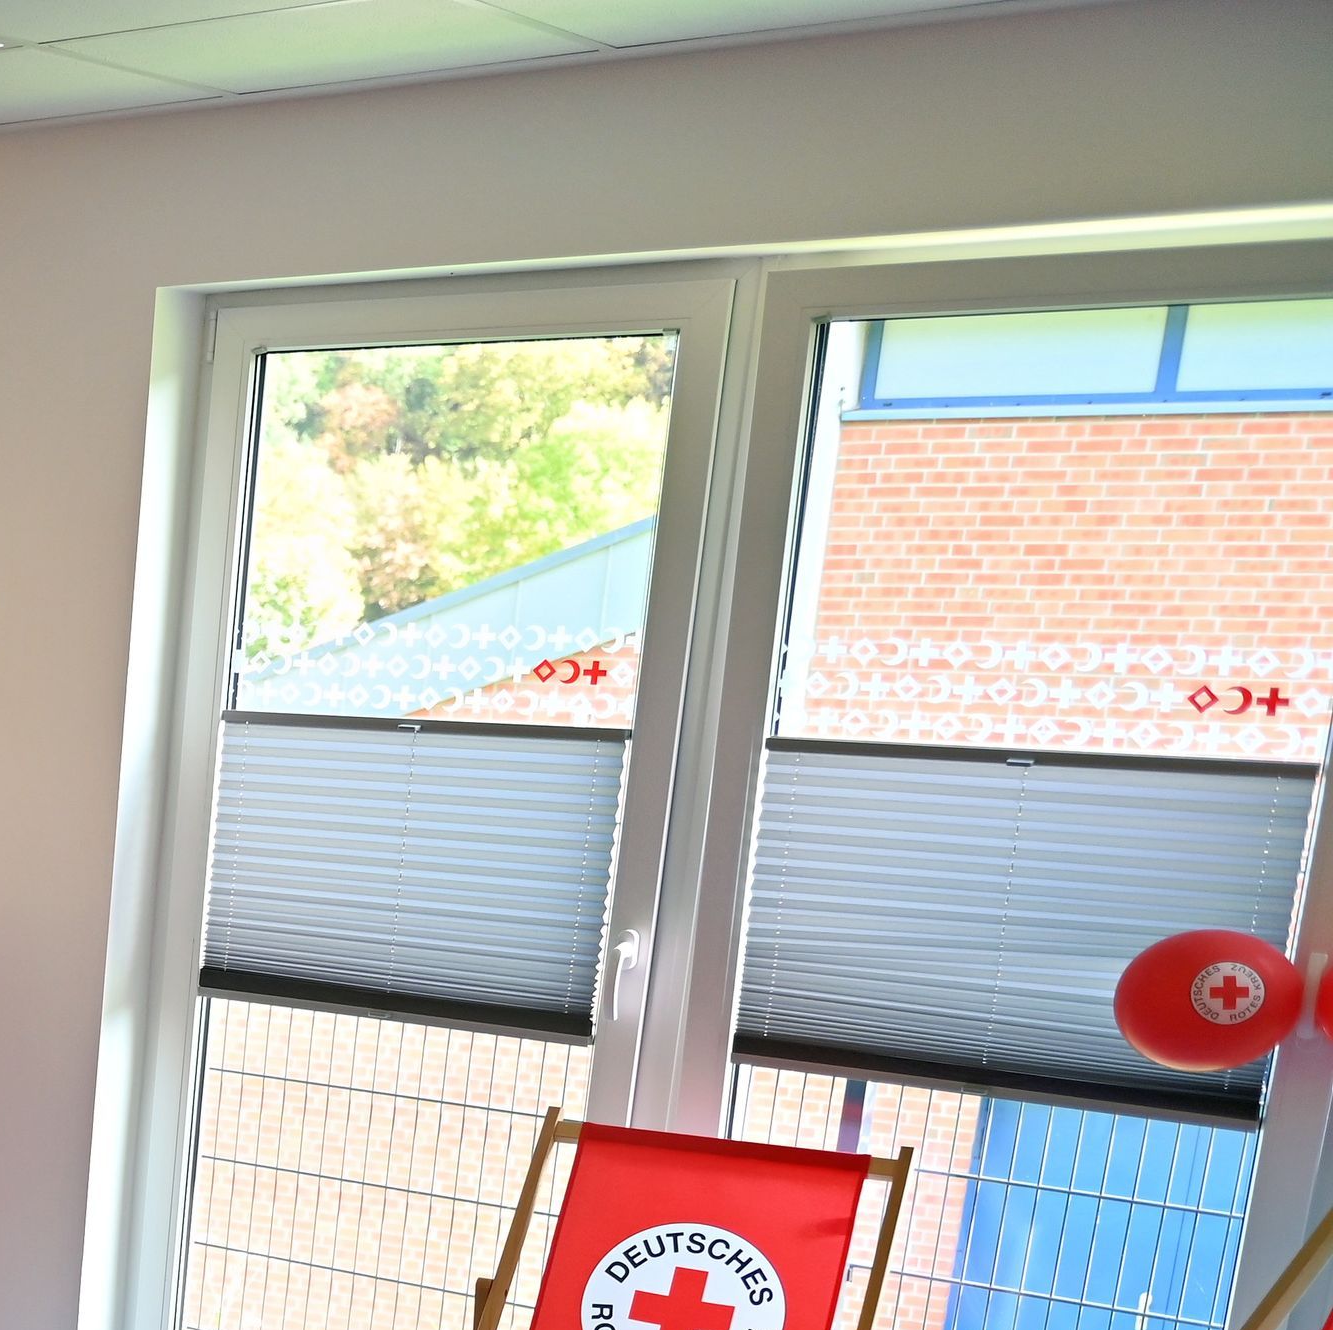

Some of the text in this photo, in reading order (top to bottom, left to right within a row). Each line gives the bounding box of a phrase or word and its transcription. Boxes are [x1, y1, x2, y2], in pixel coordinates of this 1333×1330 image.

[1193, 964, 1221, 1021] DEUTSCHES
[1229, 963, 1263, 1022] ROTES KREUZ
[604, 1232, 774, 1307] DEUTSCHES
